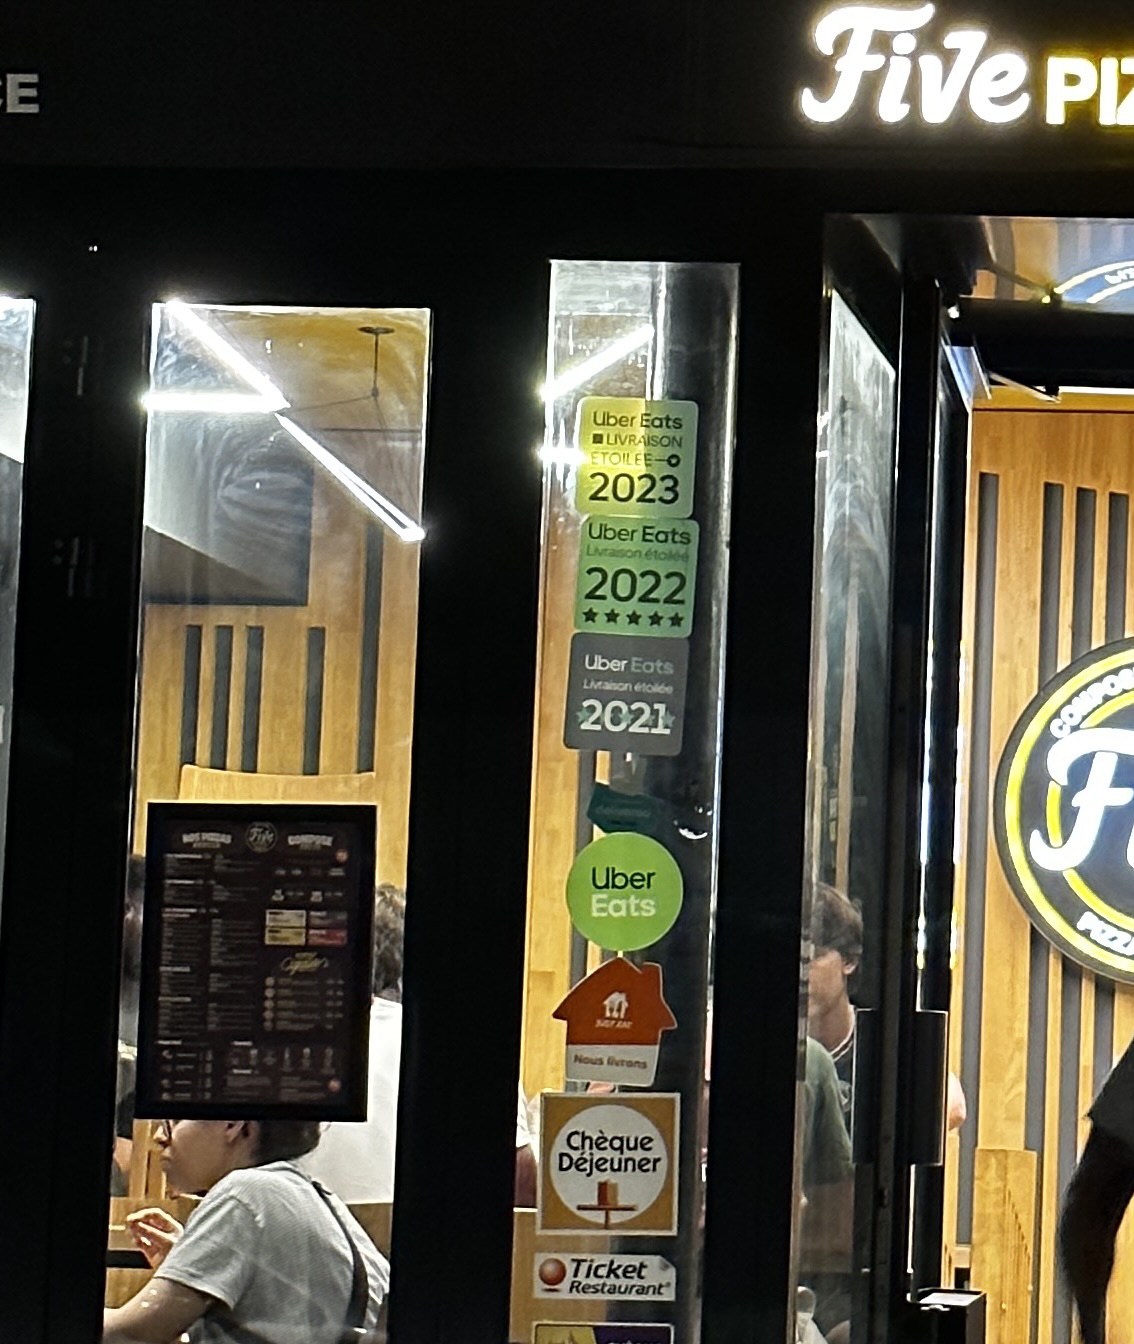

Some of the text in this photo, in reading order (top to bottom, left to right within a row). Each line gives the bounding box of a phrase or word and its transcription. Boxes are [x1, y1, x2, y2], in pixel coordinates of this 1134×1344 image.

[800, 2, 1030, 125] Five
[0, 73, 40, 113] E
[593, 411, 683, 430] Uber Eats
[606, 432, 683, 448] LIVRAISON
[588, 472, 680, 505] 2023
[588, 522, 691, 545] Uber Eats
[584, 566, 687, 605] 2022
[584, 654, 674, 675] Uber Eats
[583, 677, 632, 691] Livraison
[580, 698, 671, 735] 2021
[591, 866, 656, 890] Uber
[591, 892, 656, 918] Eats
[573, 1053, 648, 1070] Nous livrons
[566, 1129, 655, 1156] Chèque
[558, 1151, 663, 1178] Déjeuner
[570, 1257, 648, 1280] Ticket
